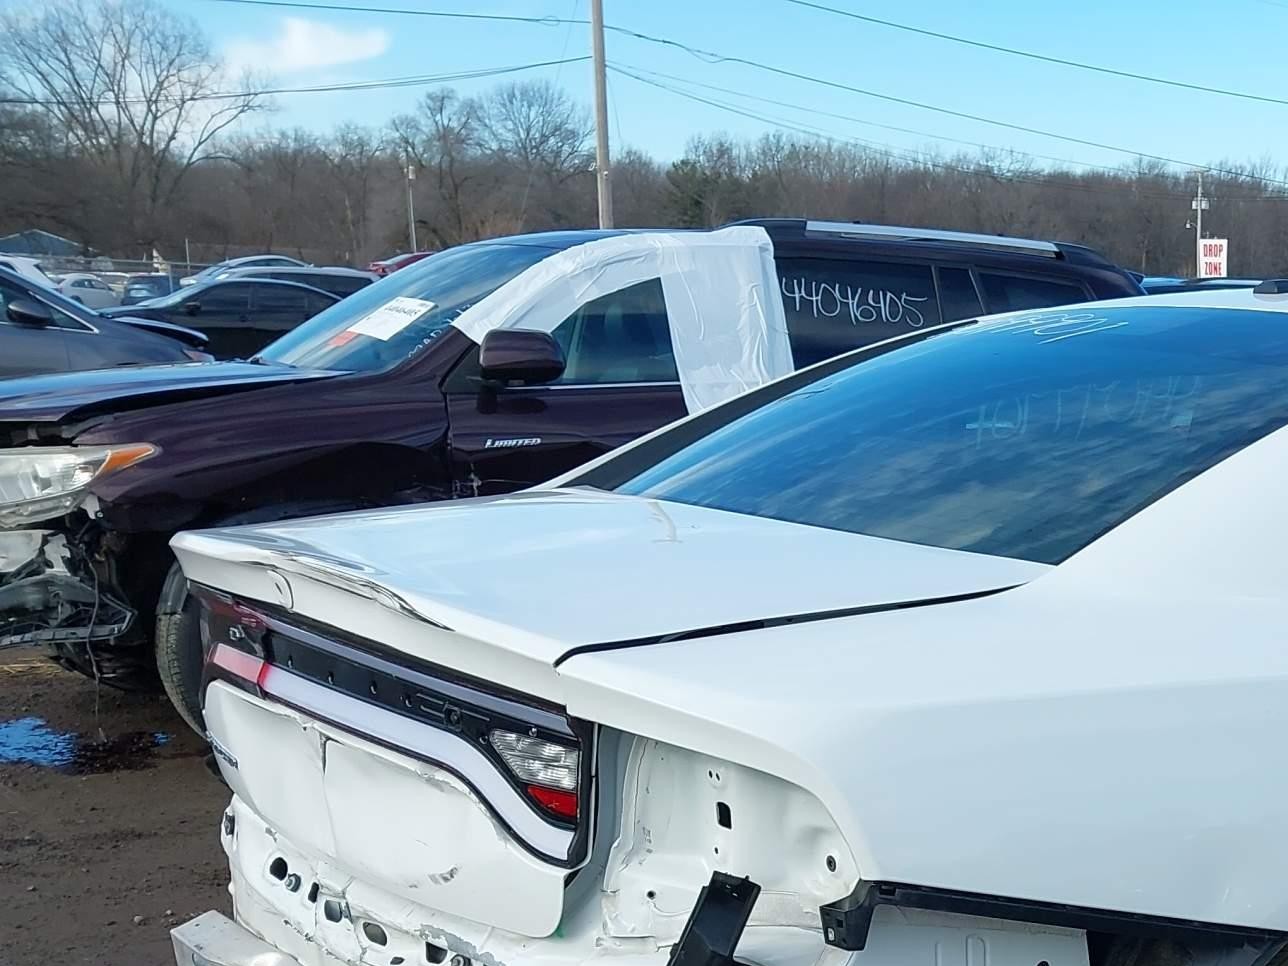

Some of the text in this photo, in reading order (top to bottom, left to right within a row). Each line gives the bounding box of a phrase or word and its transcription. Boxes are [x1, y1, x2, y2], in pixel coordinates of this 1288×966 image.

[1203, 243, 1223, 258] DROP
[1204, 261, 1222, 276] ZONE
[782, 276, 928, 328] 44046405
